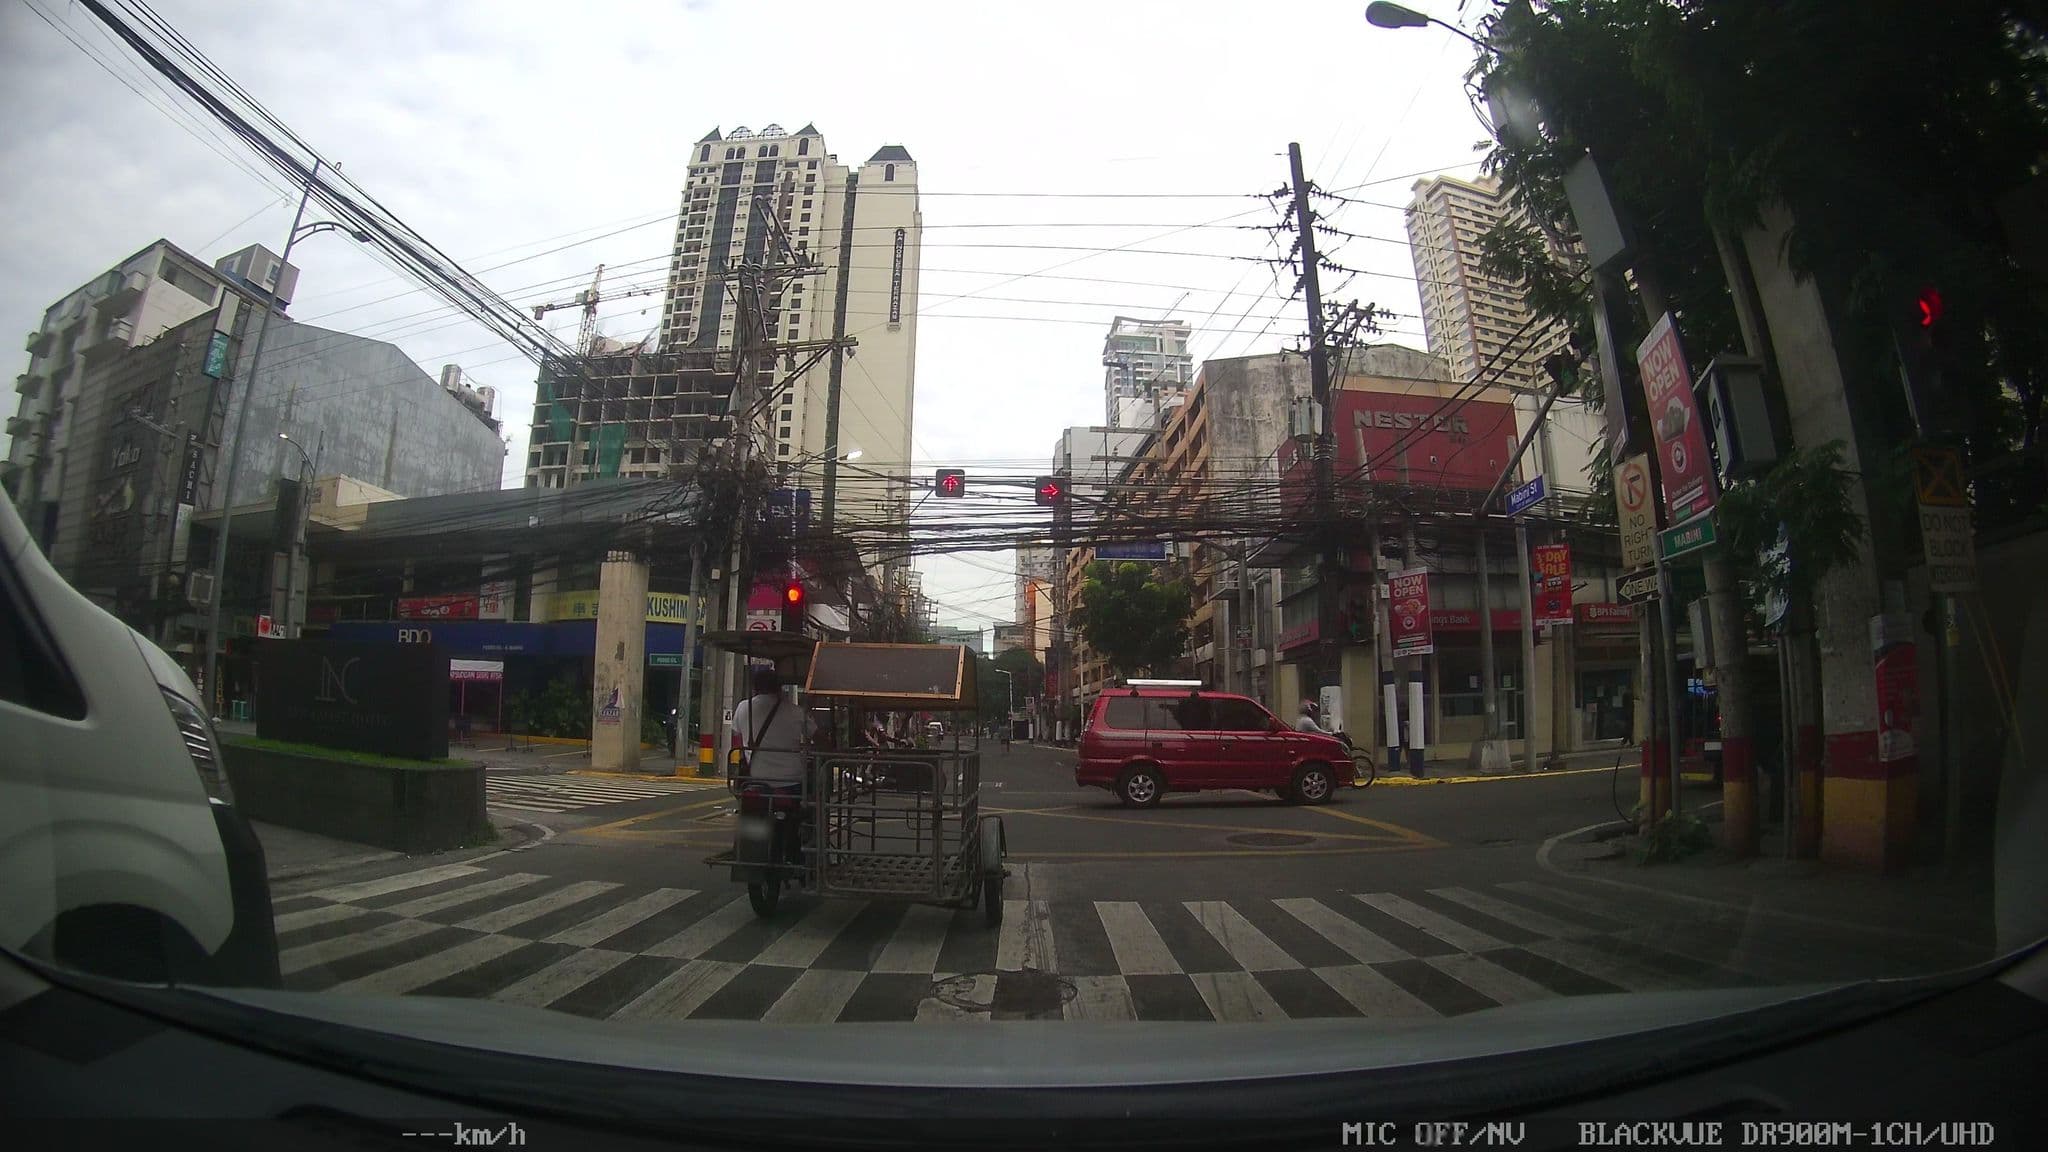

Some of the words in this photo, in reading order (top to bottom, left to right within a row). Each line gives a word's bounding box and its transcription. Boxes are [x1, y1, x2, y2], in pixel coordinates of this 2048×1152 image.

[1644, 335, 1672, 379] NOW
[1649, 359, 1680, 401] OPEN
[1629, 514, 1645, 528] NO
[1674, 528, 1702, 547] MABINI
[1538, 563, 1568, 577] SALE
[1393, 575, 1422, 588] NOW
[1625, 580, 1643, 596] ONE
[1645, 575, 1658, 592] WA
[1393, 585, 1424, 598] OPEN
[1450, 614, 1471, 625] Bank
